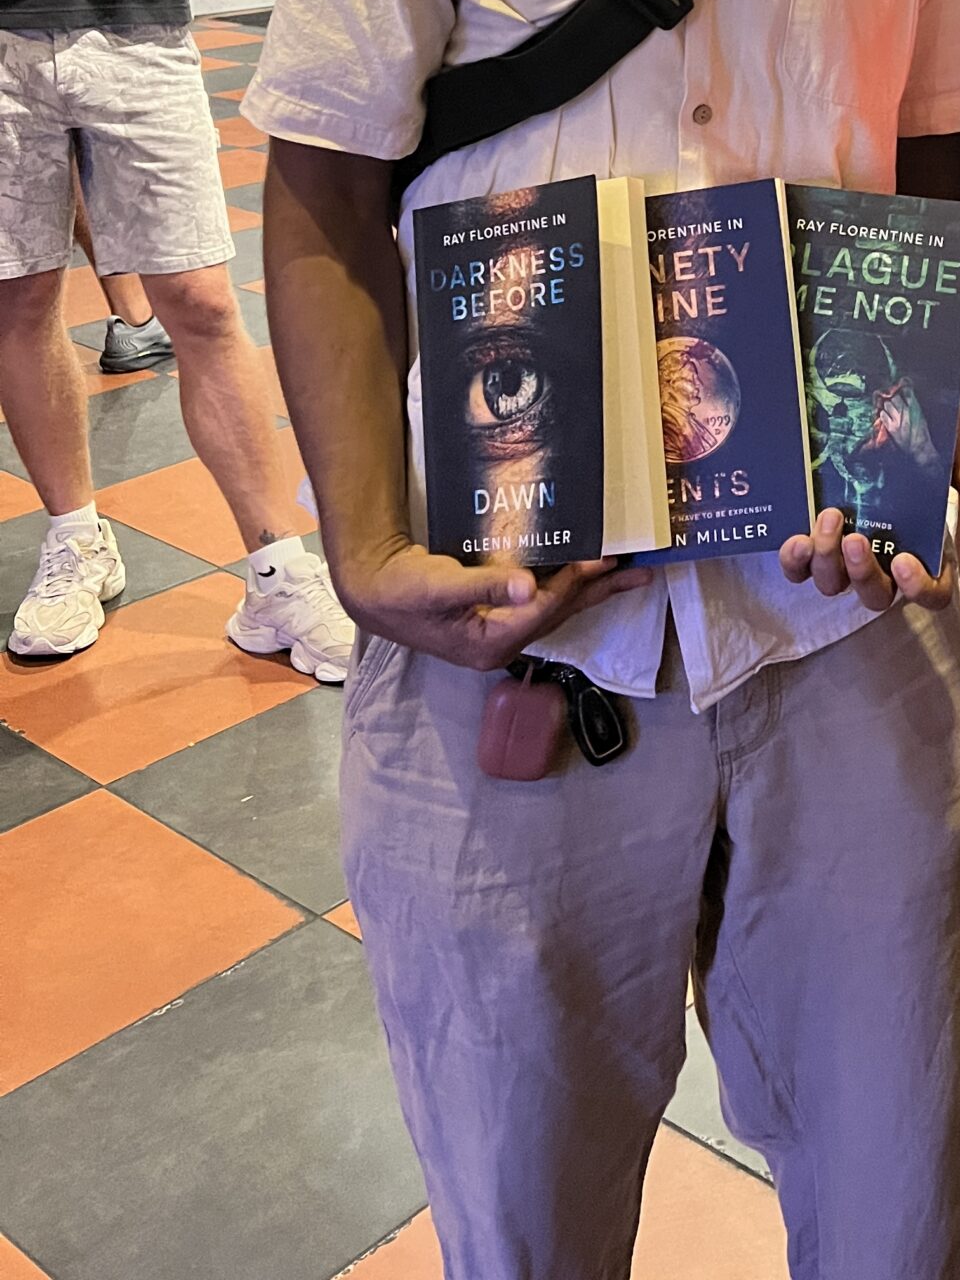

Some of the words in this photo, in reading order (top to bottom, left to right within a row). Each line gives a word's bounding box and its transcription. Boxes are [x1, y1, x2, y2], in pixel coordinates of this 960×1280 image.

[443, 231, 467, 247] RAY
[469, 216, 549, 242] FLORENTINE
[552, 213, 567, 226] IN
[647, 220, 722, 242] ORENTINE
[727, 218, 743, 230] IN
[796, 218, 826, 233] RAY
[829, 222, 925, 246] FLORENTINE
[928, 234, 945, 248] IN
[430, 242, 585, 292] DARKNESS
[650, 242, 750, 283] NETY
[791, 242, 960, 294] LAGUE
[452, 278, 565, 321] BEFORE
[657, 284, 727, 322] INE
[853, 290, 941, 329] NOT
[474, 481, 556, 515] DAWN
[678, 513, 699, 522] HAVE
[716, 510, 726, 518] BE
[728, 504, 773, 516] EXPENSIVE
[697, 523, 768, 545] MILLER
[845, 516, 854, 524] LL
[856, 519, 893, 530] WOUNDS
[462, 536, 511, 553] GLENN
[518, 530, 571, 548] MILLER
